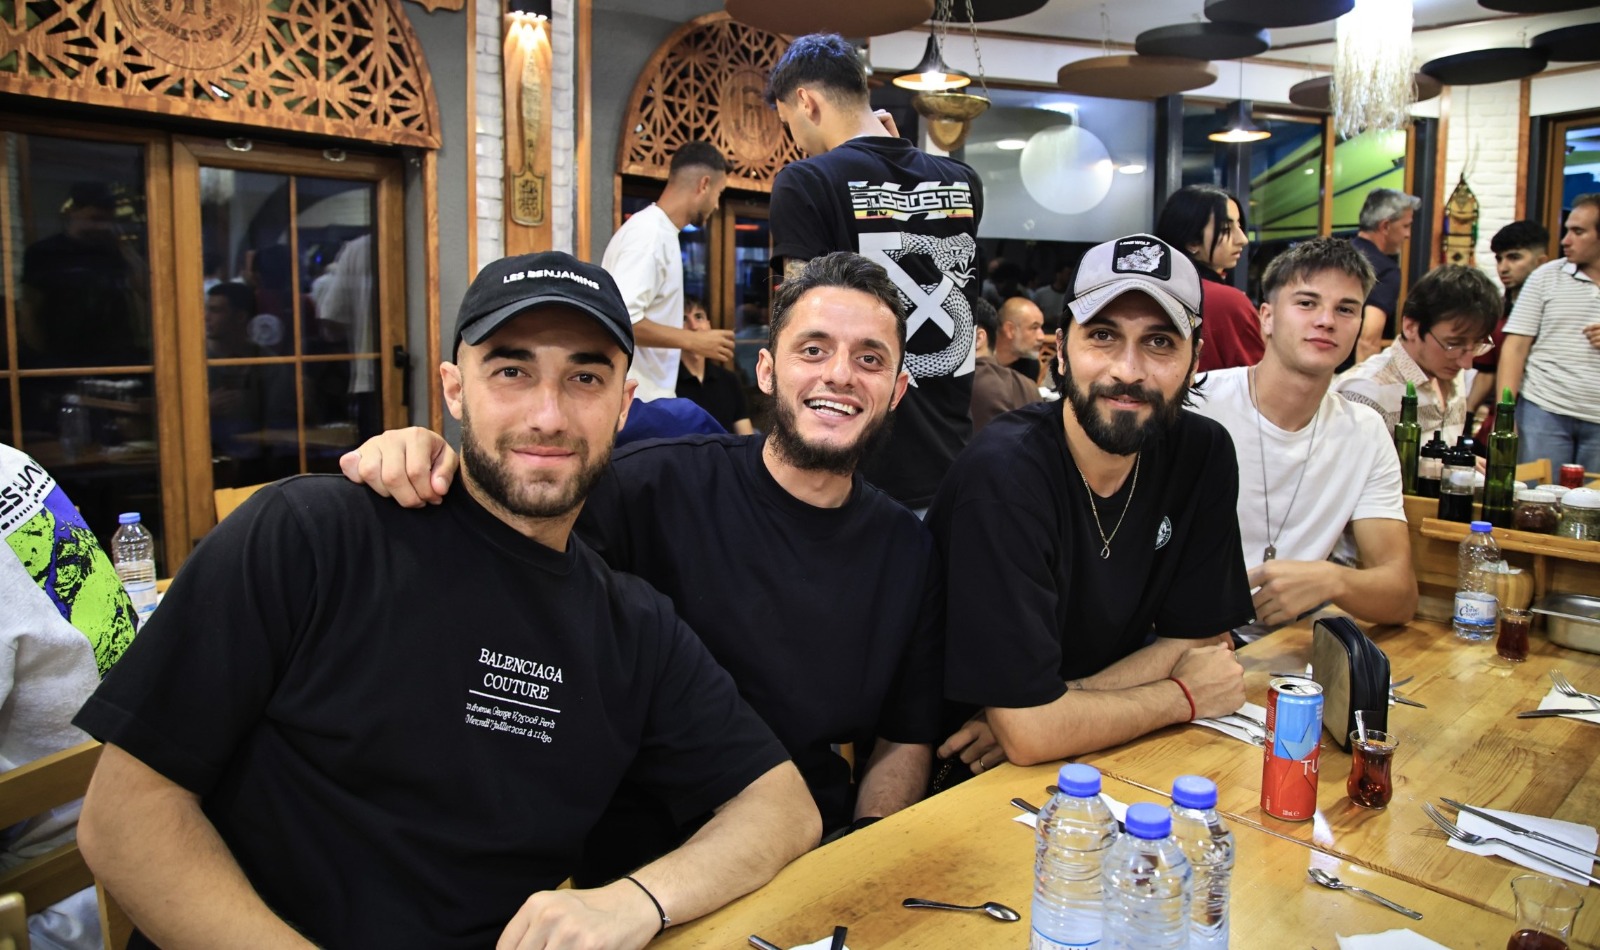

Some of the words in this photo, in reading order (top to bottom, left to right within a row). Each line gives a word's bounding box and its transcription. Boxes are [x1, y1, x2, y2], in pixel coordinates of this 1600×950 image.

[503, 272, 525, 283] LES
[527, 269, 600, 290] BENJAMINS
[479, 648, 563, 683] BALENCIAGA
[484, 673, 550, 700] COUTURE
[492, 706, 512, 720] George
[538, 717, 556, 729] Paris
